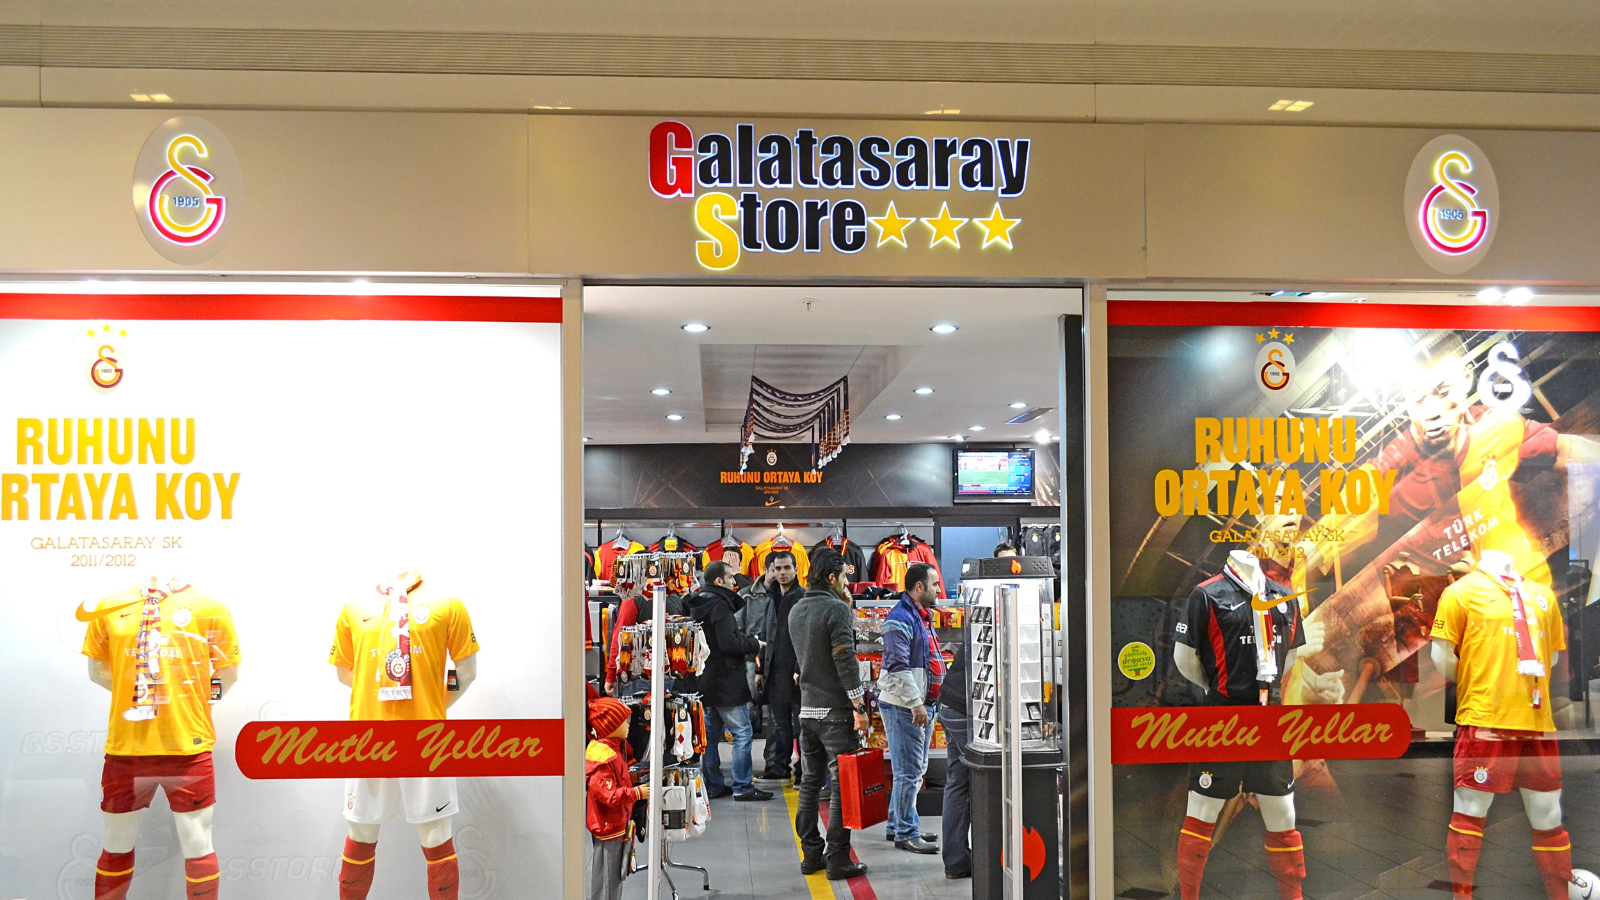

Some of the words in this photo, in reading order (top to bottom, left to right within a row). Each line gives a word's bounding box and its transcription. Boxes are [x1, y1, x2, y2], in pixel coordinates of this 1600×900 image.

[648, 120, 1031, 199] Galatasaray
[173, 196, 201, 207] 1905
[1440, 209, 1464, 220] 1905
[694, 191, 868, 271] Store
[16, 417, 196, 465] RUHUNU
[1195, 417, 1357, 464] RUHUNU
[720, 471, 761, 484] RUHUNU
[763, 471, 801, 484] ORTAYA
[803, 471, 824, 484] KOY
[1154, 469, 1306, 517] ORTAYA
[1320, 469, 1398, 515] KOY
[0, 473, 139, 521] RTAYA
[155, 472, 241, 520] KOY
[1209, 529, 1321, 543] GALATASARAY
[1326, 529, 1345, 542] SK
[1433, 516, 1499, 561] TELEKOM
[1443, 508, 1484, 540] TÜRK
[30, 537, 156, 550] GALATASARAY
[162, 537, 182, 549] SK
[70, 554, 136, 567] 2011/2012
[1246, 546, 1305, 559] 2011/2012
[256, 725, 397, 765] Mutlu
[1131, 712, 1261, 749] Mutlu
